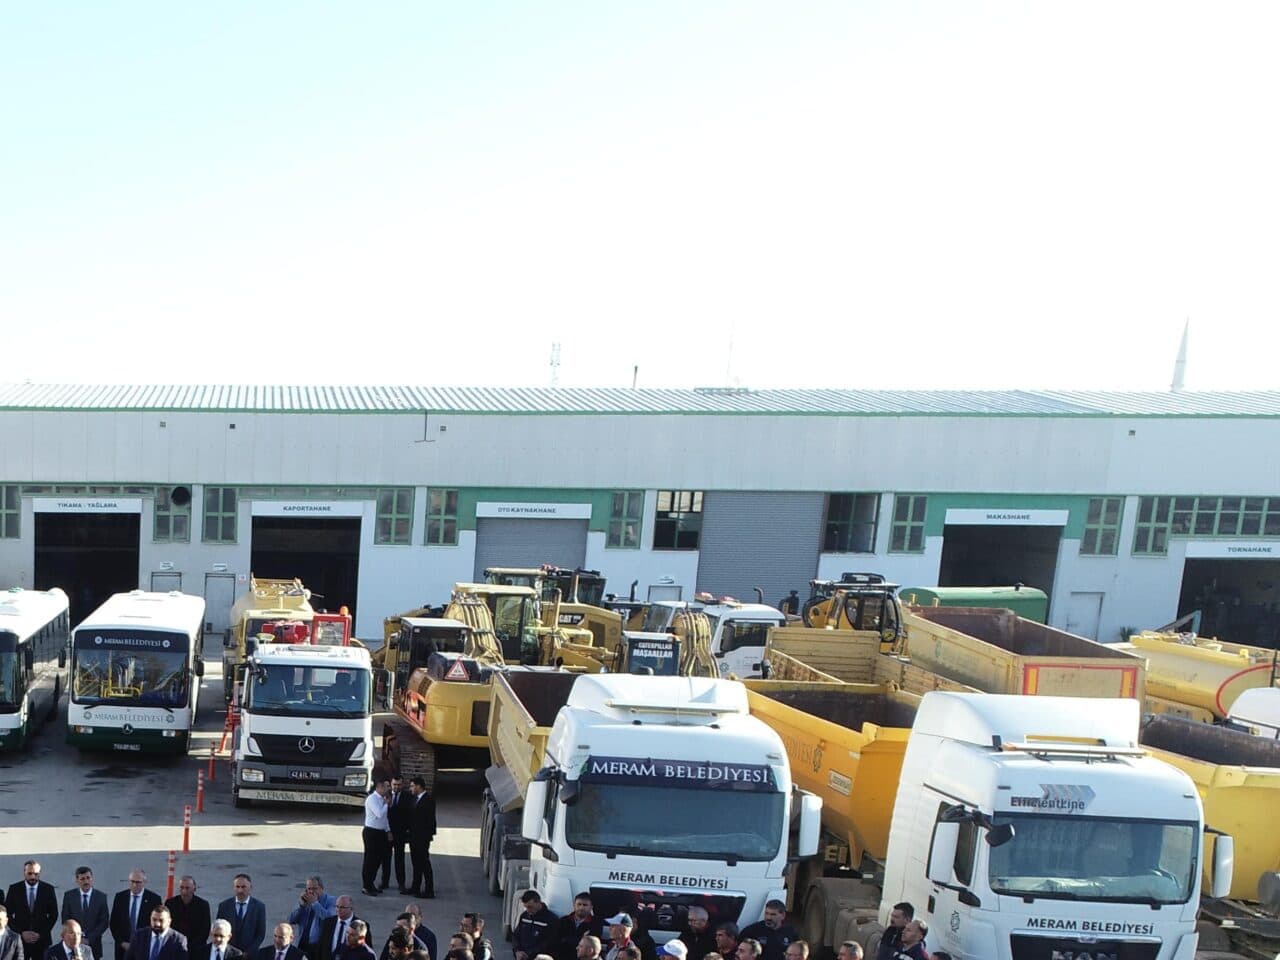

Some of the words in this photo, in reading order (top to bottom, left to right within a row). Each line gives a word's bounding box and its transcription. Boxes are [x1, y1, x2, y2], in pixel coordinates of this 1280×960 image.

[88, 501, 117, 509] YAĞLAMA
[559, 615, 572, 623] CAT
[95, 712, 119, 720] MERAM
[592, 762, 656, 776] MERAM
[665, 765, 768, 783] BELEDİYESİ
[257, 791, 294, 800] MERAM
[609, 871, 656, 884] MERAM
[660, 874, 728, 889] BELEDİYESİ
[1027, 917, 1077, 930] MERAM
[1082, 921, 1153, 934] BELEDİYESİ
